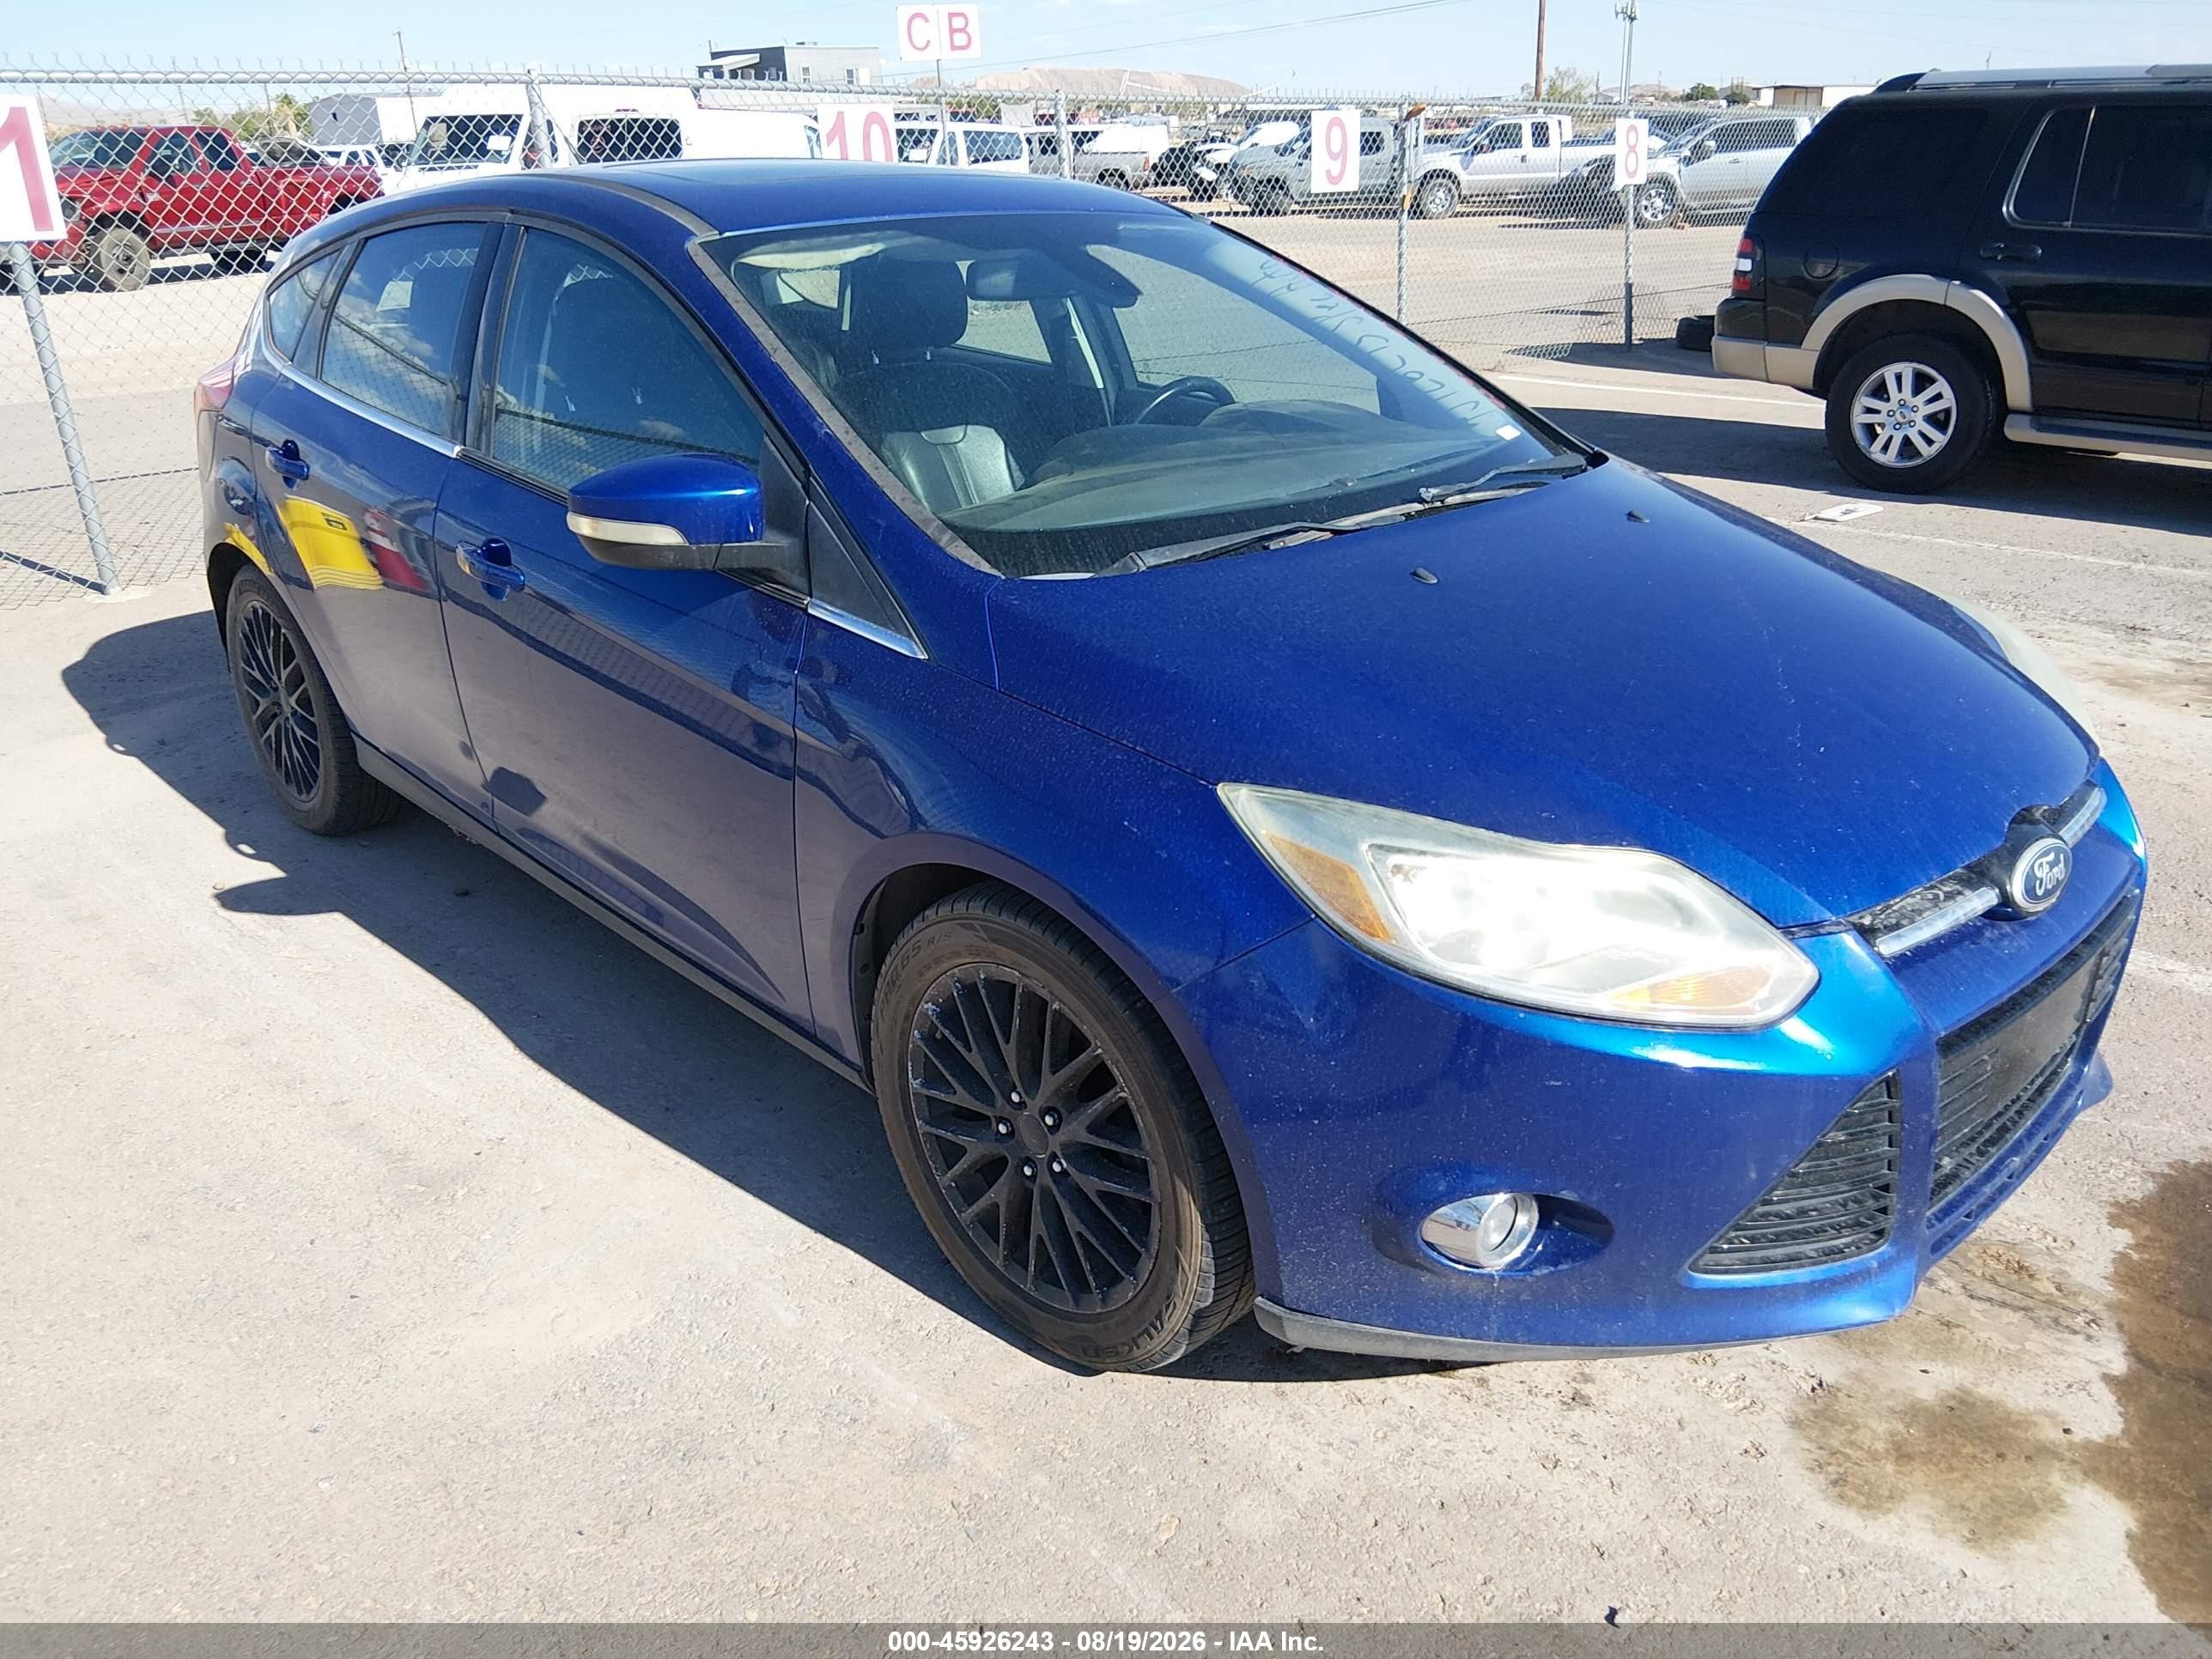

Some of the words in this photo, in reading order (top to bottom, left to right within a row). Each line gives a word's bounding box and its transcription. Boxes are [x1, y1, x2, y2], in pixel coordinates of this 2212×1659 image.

[907, 12, 931, 52] C
[947, 12, 972, 51] B
[826, 111, 893, 161] 10
[1325, 116, 1348, 185] 9
[1626, 125, 1638, 179] 8
[2033, 851, 2064, 896] Ford
